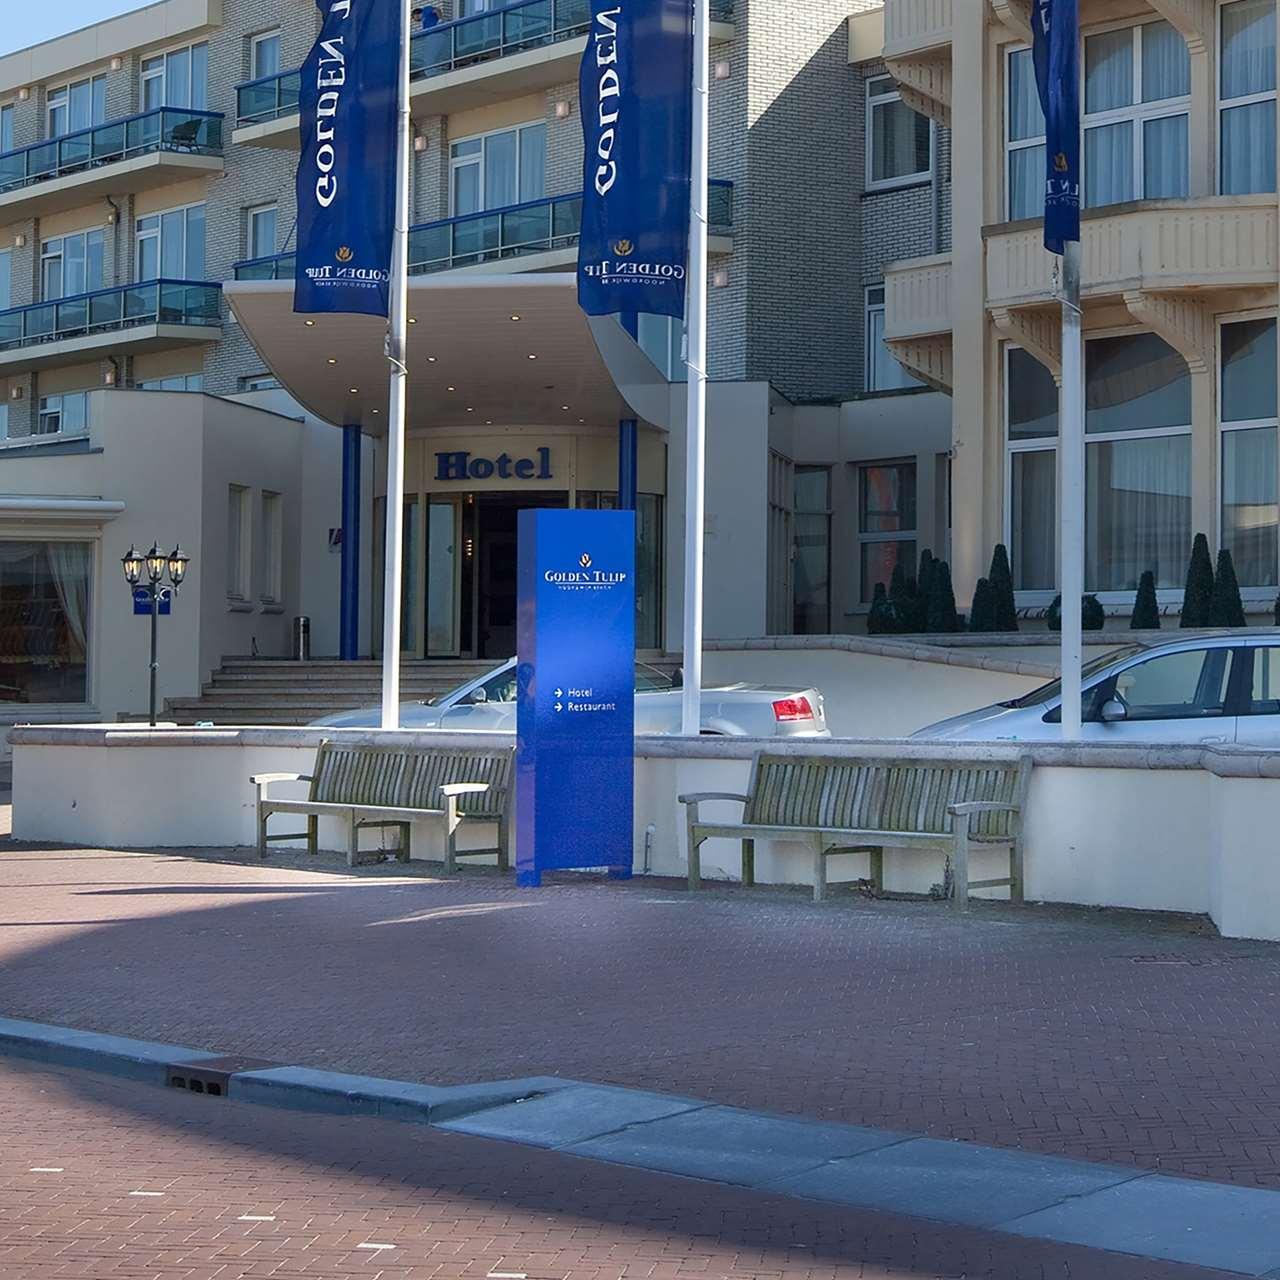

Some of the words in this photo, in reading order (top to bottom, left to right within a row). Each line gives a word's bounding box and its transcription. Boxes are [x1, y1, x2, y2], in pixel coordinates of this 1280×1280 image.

[434, 447, 553, 480] Hotel
[544, 570, 590, 582] GOLDEN
[593, 570, 626, 582] TULIP
[567, 687, 593, 697] Hotel
[567, 701, 616, 711] Restaurant
